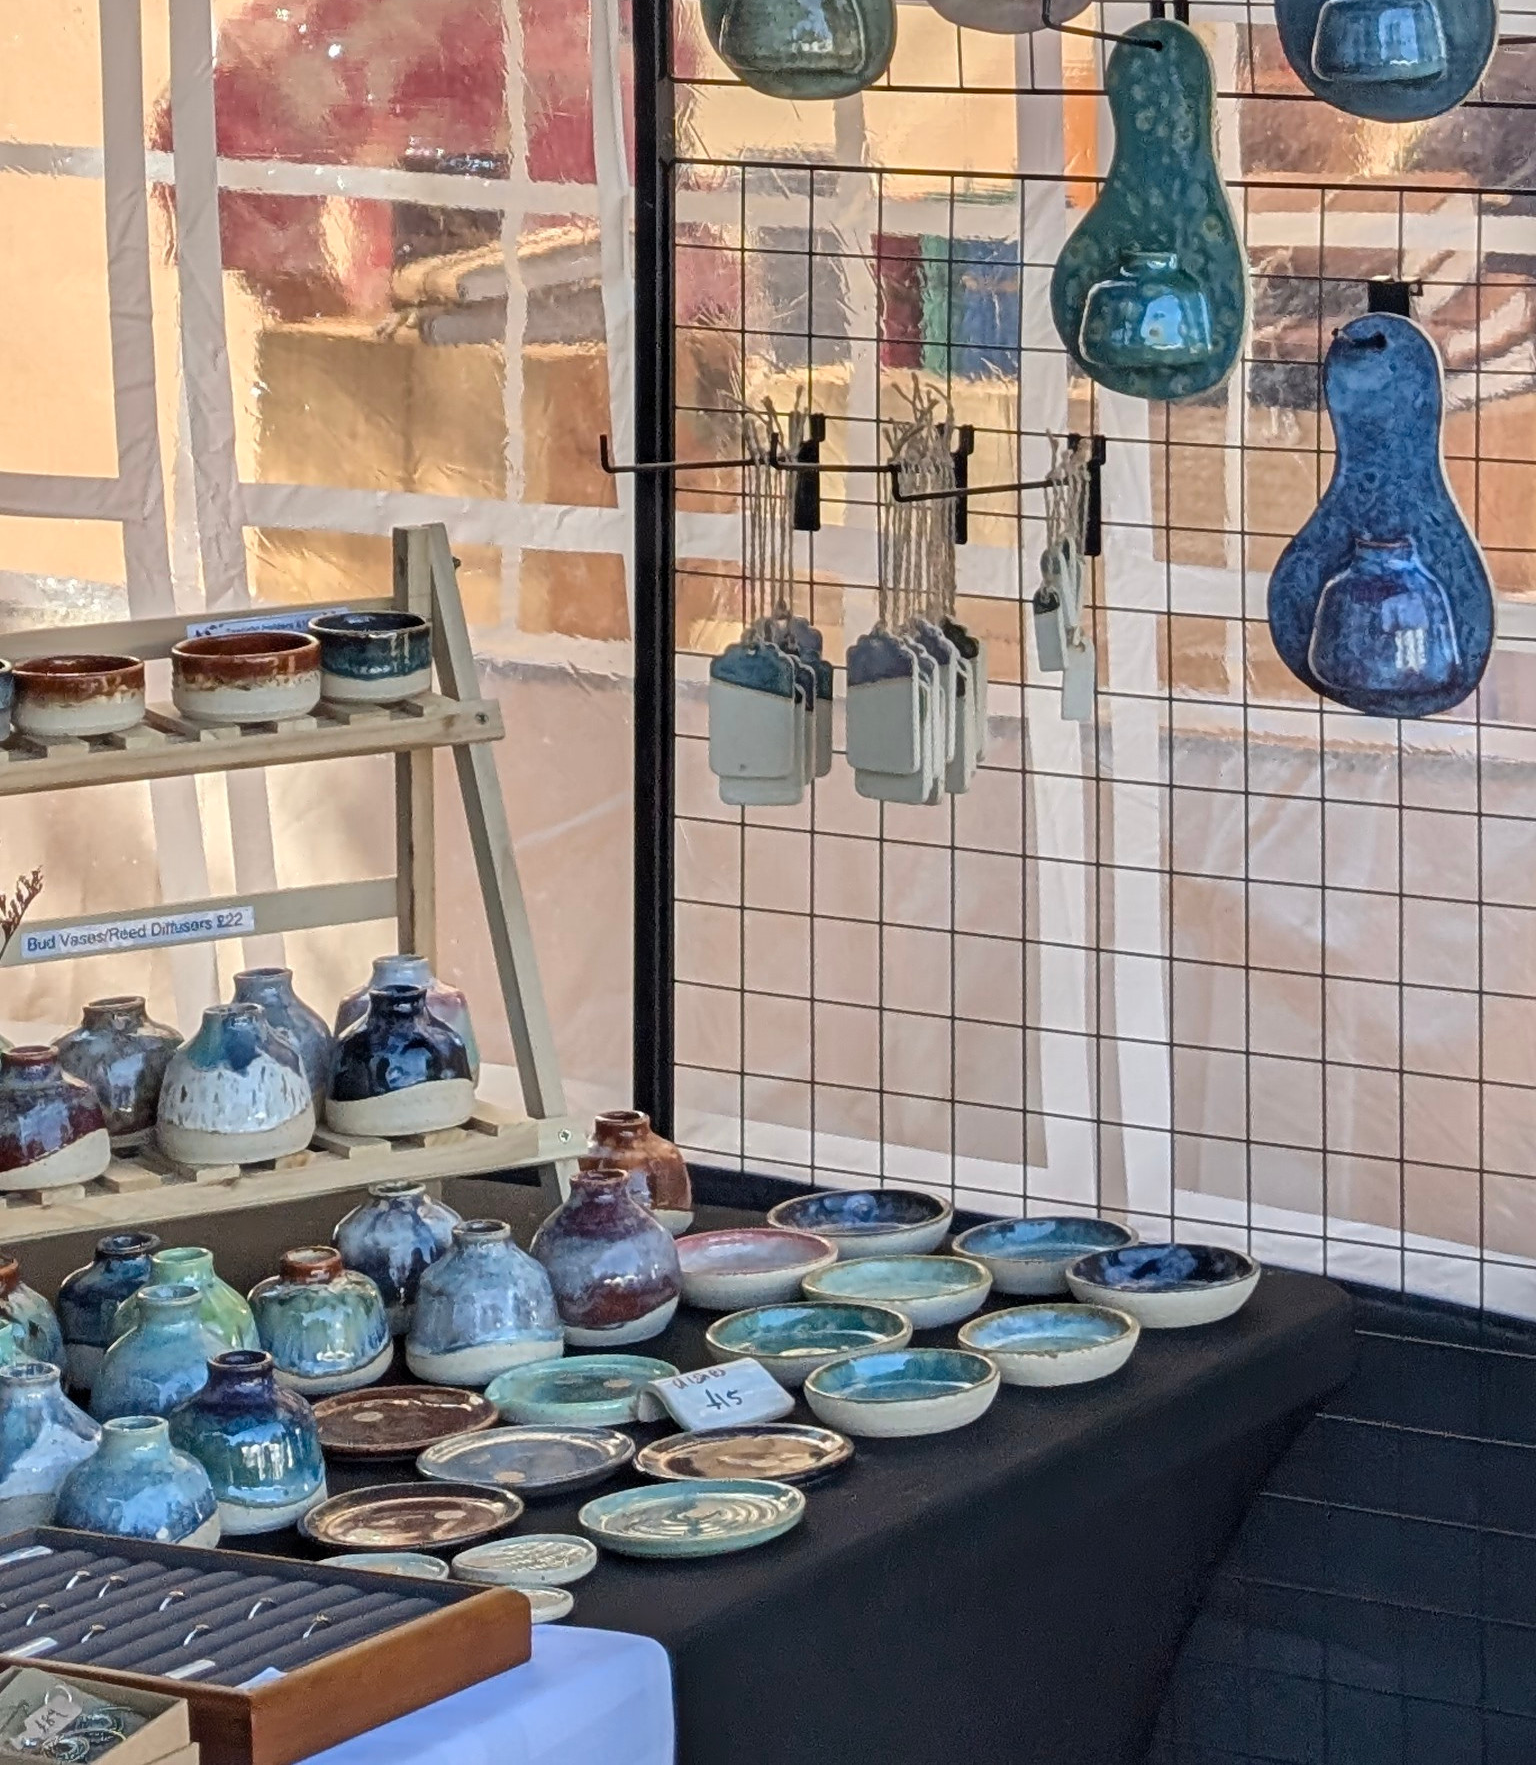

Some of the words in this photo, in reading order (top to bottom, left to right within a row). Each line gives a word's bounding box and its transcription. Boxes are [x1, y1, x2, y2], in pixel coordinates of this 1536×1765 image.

[27, 936, 56, 952] Bud
[58, 925, 147, 947] Vases/Reed
[216, 911, 243, 928] £22
[705, 1388, 743, 1410] £15
